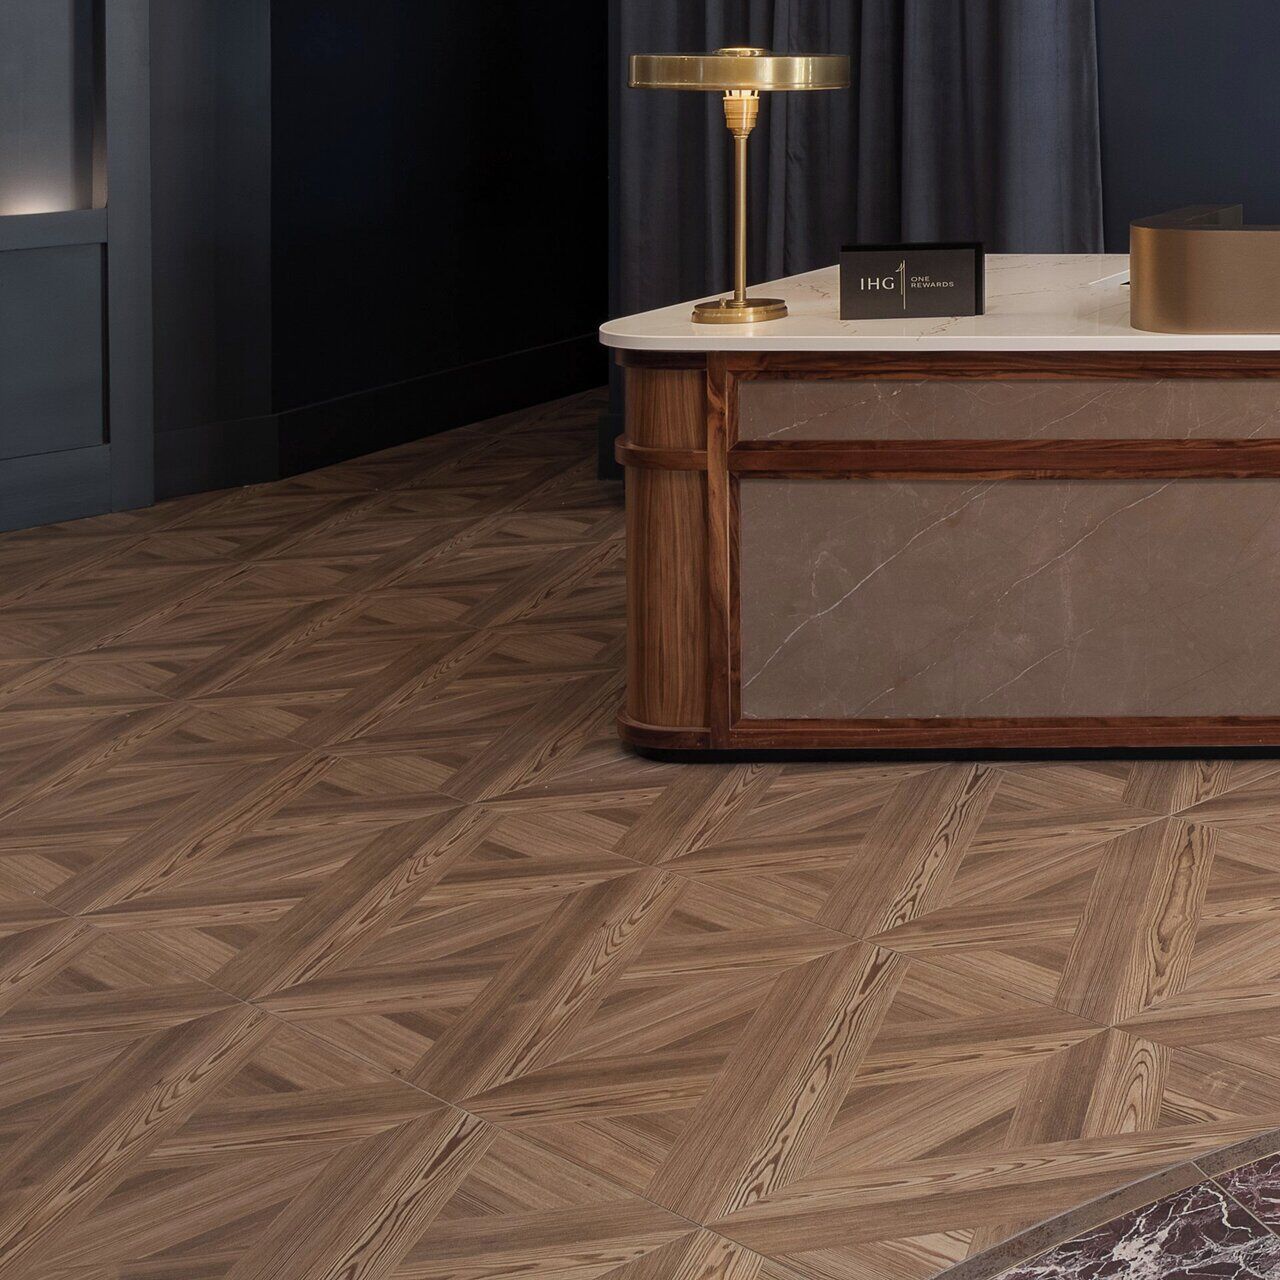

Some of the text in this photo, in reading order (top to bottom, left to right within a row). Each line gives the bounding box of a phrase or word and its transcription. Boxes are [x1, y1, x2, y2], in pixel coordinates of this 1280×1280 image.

[910, 275, 931, 283] ONE
[860, 276, 895, 291] IHG
[910, 281, 955, 289] REWARDS
